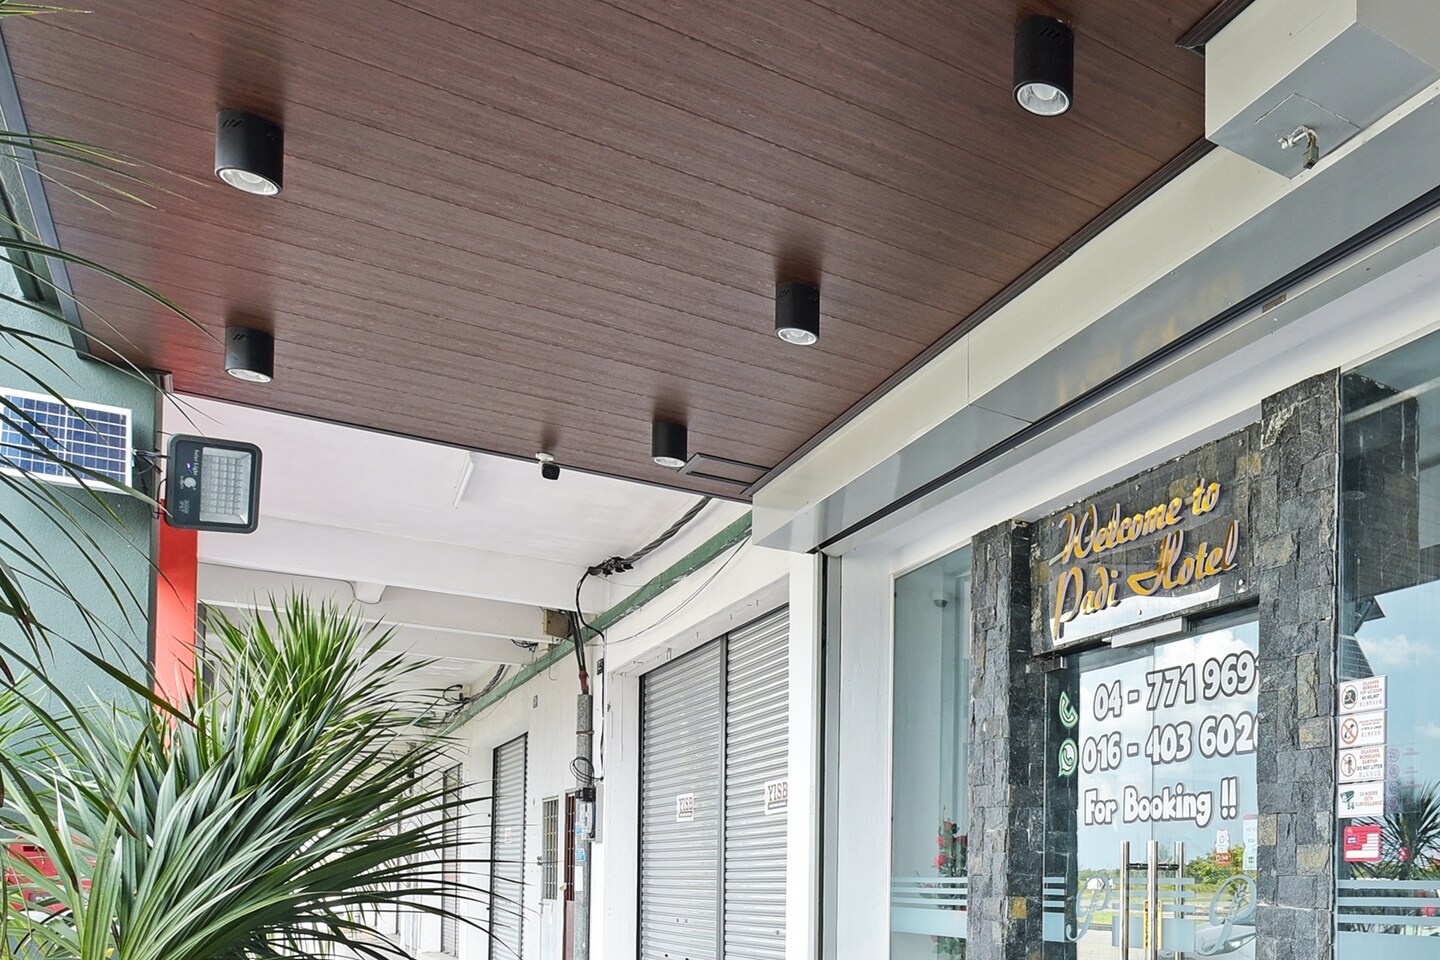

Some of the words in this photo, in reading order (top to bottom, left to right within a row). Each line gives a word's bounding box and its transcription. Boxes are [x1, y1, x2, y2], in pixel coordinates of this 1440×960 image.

[1059, 497, 1182, 564] Welcome
[1192, 478, 1221, 515] to
[1052, 566, 1119, 640] Padi
[1127, 519, 1239, 596] Hotel
[1093, 679, 1122, 721] 04
[1145, 663, 1196, 711] 771
[1202, 650, 1259, 700] 969
[1082, 731, 1122, 774] 016
[1145, 721, 1192, 765] 403
[1084, 788, 1118, 826] For
[1123, 783, 1212, 828] Booking
[1220, 776, 1238, 820] !!
